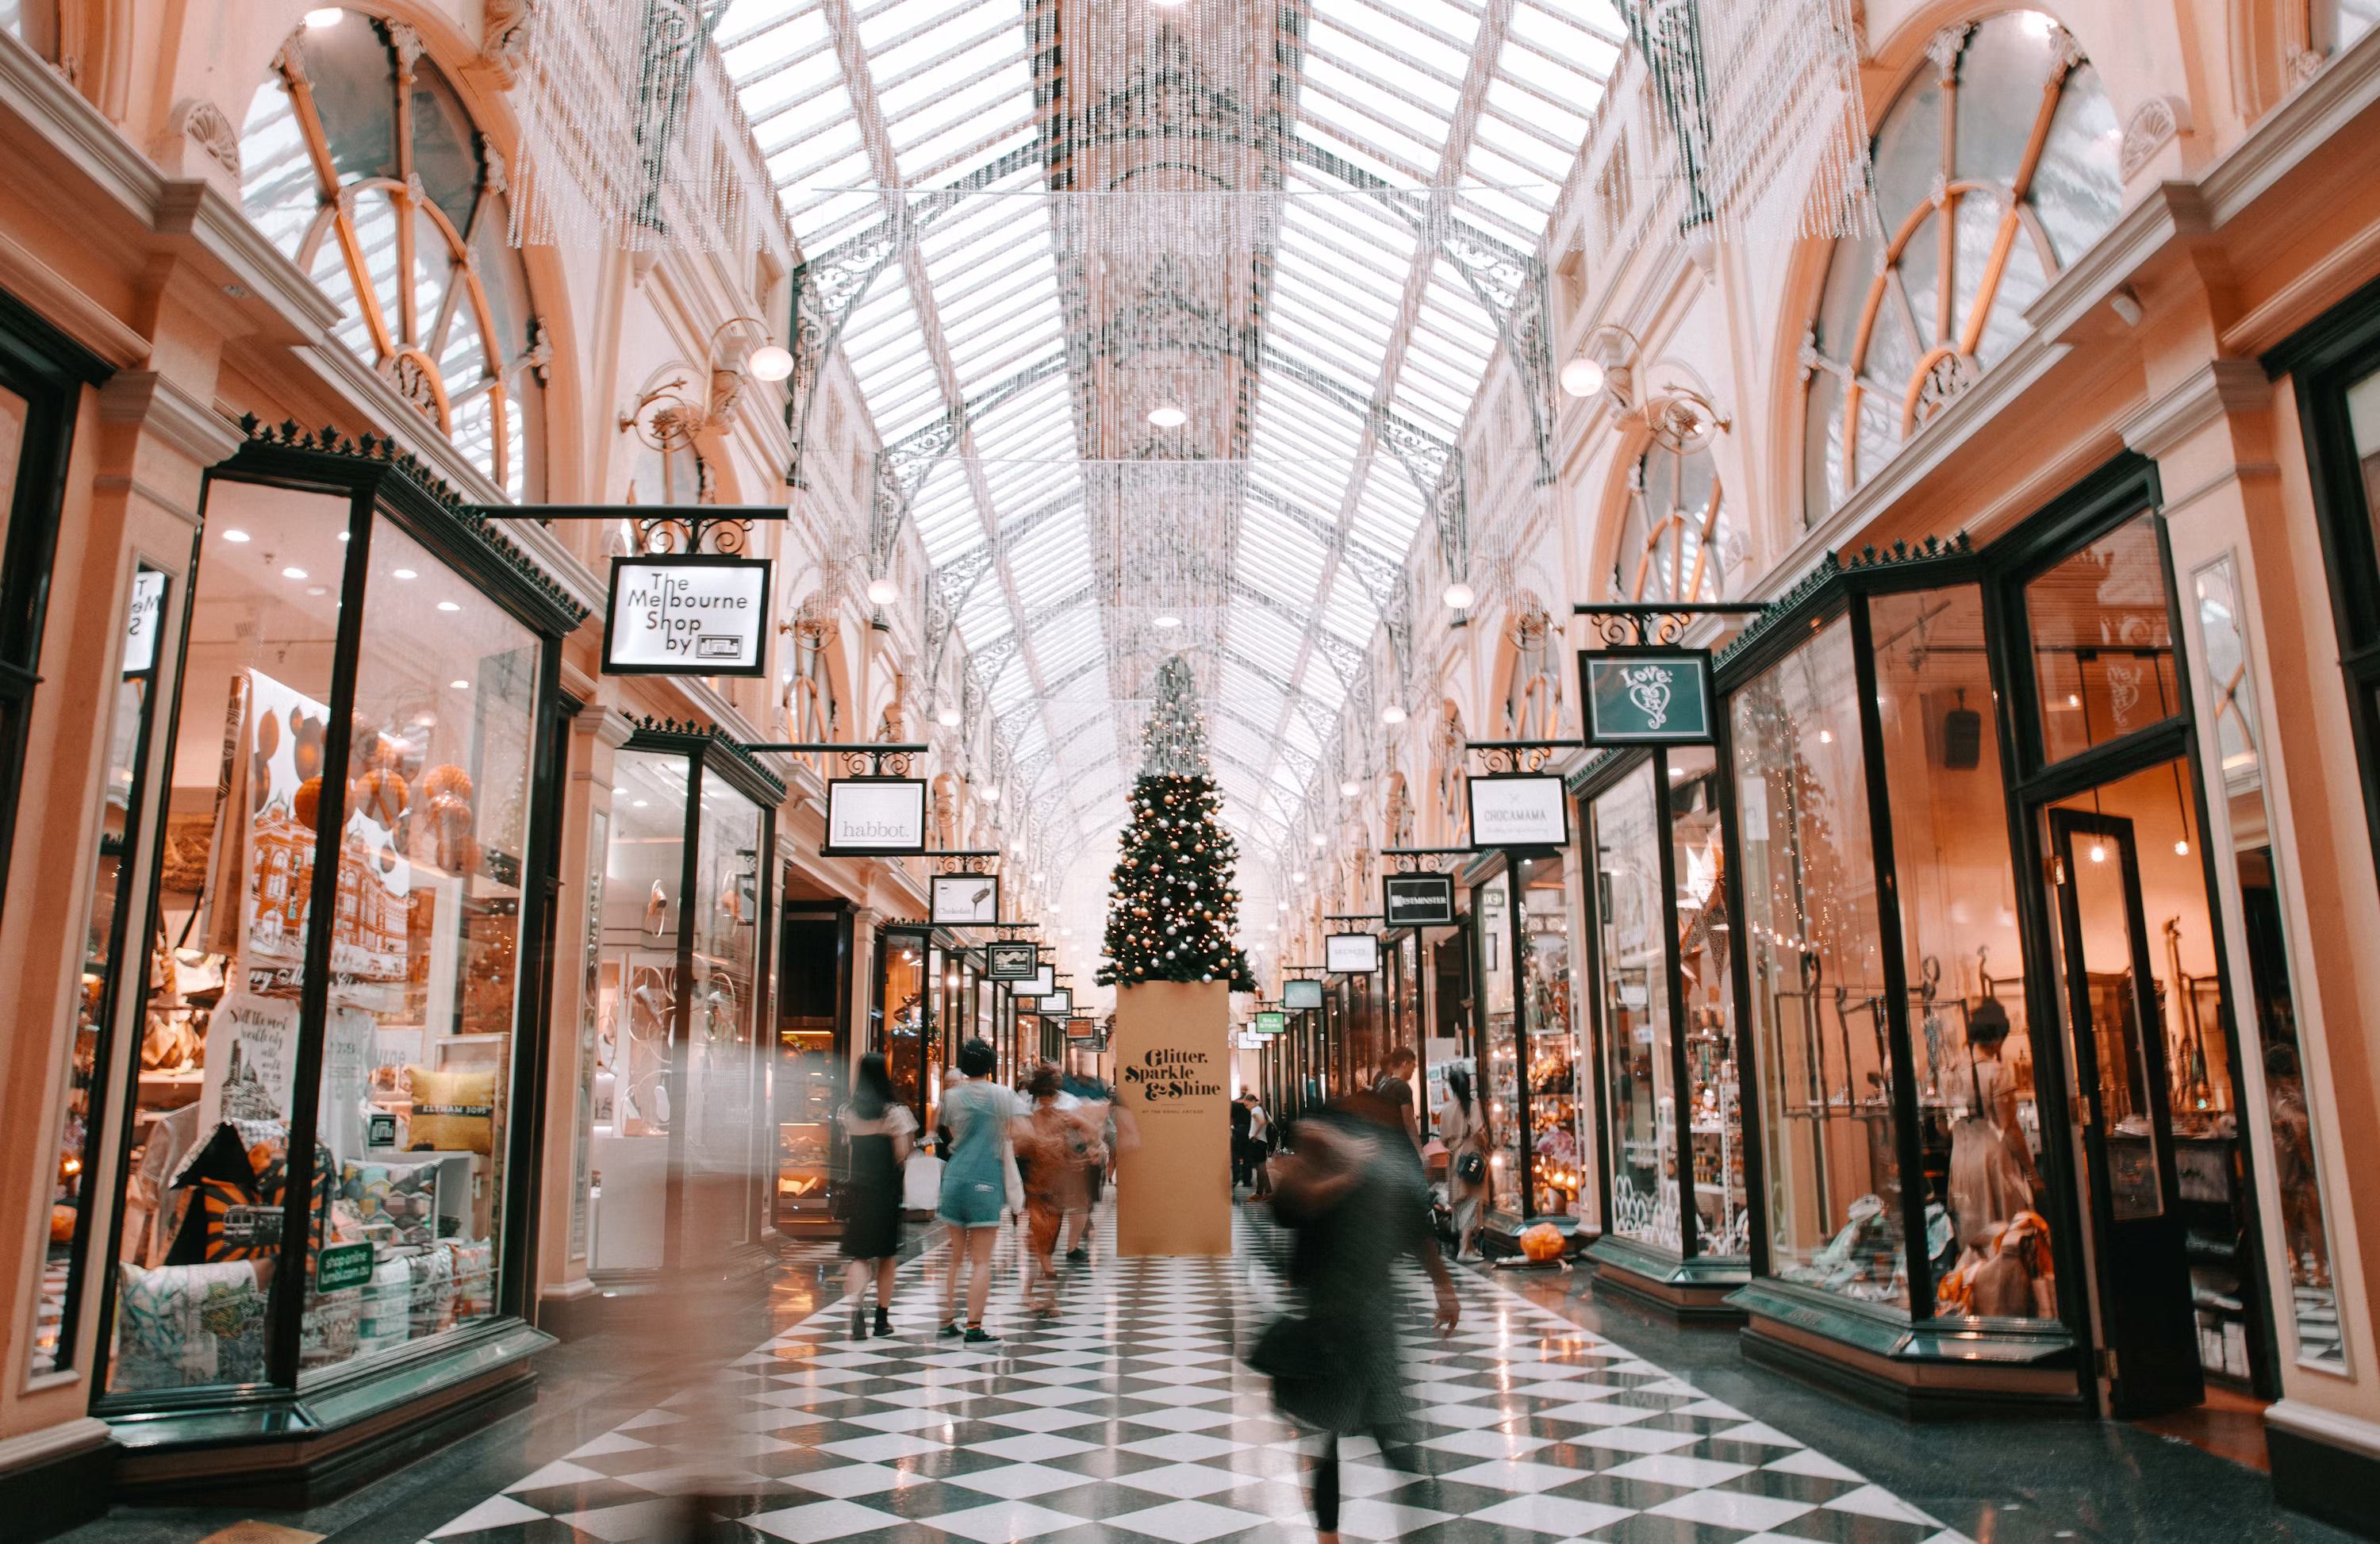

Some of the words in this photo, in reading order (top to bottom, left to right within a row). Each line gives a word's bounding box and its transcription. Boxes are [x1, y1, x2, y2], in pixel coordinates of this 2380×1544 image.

[651, 573, 689, 590] The
[628, 590, 748, 609] Melbourne
[646, 611, 701, 635] Shop
[666, 636, 692, 655] by
[1484, 809, 1547, 822] CHOCAMAMA
[1125, 1065, 1194, 1085] Sparkle
